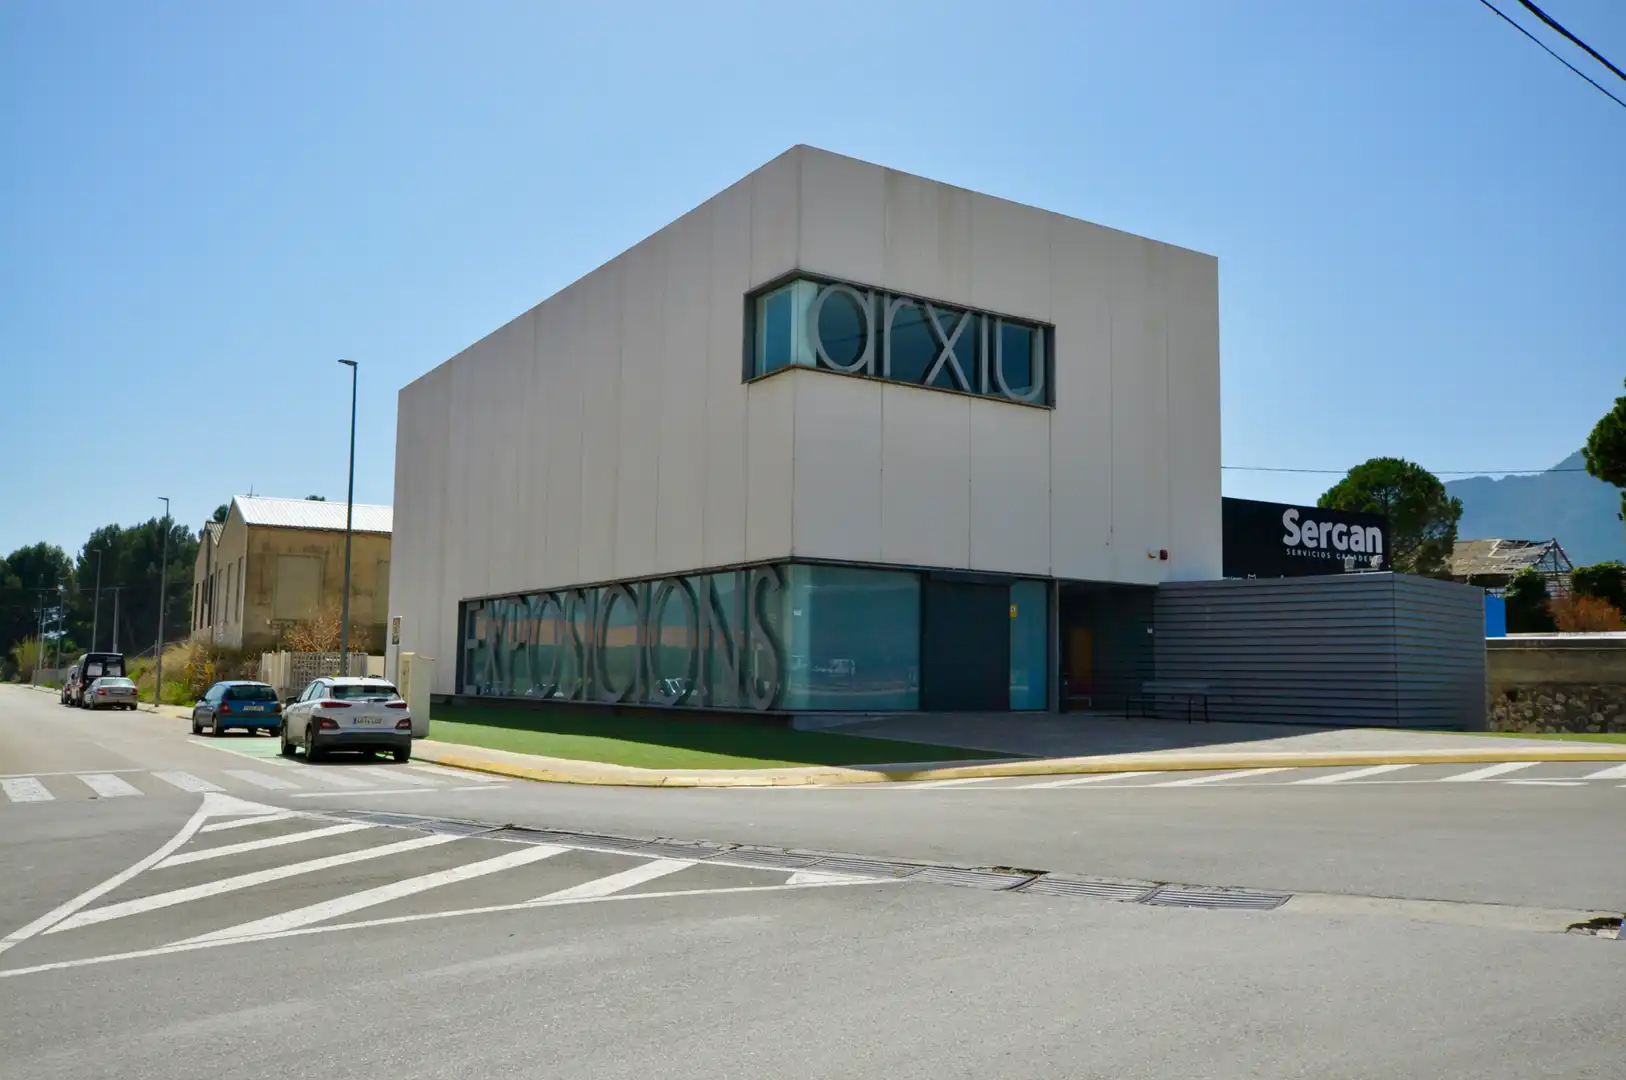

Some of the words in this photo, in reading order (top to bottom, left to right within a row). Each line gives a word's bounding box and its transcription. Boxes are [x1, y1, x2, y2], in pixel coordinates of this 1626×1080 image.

[815, 285, 1044, 401] arxiu
[1286, 548, 1331, 559] SERVICIOS
[463, 566, 780, 711] EXPOSICIONS
